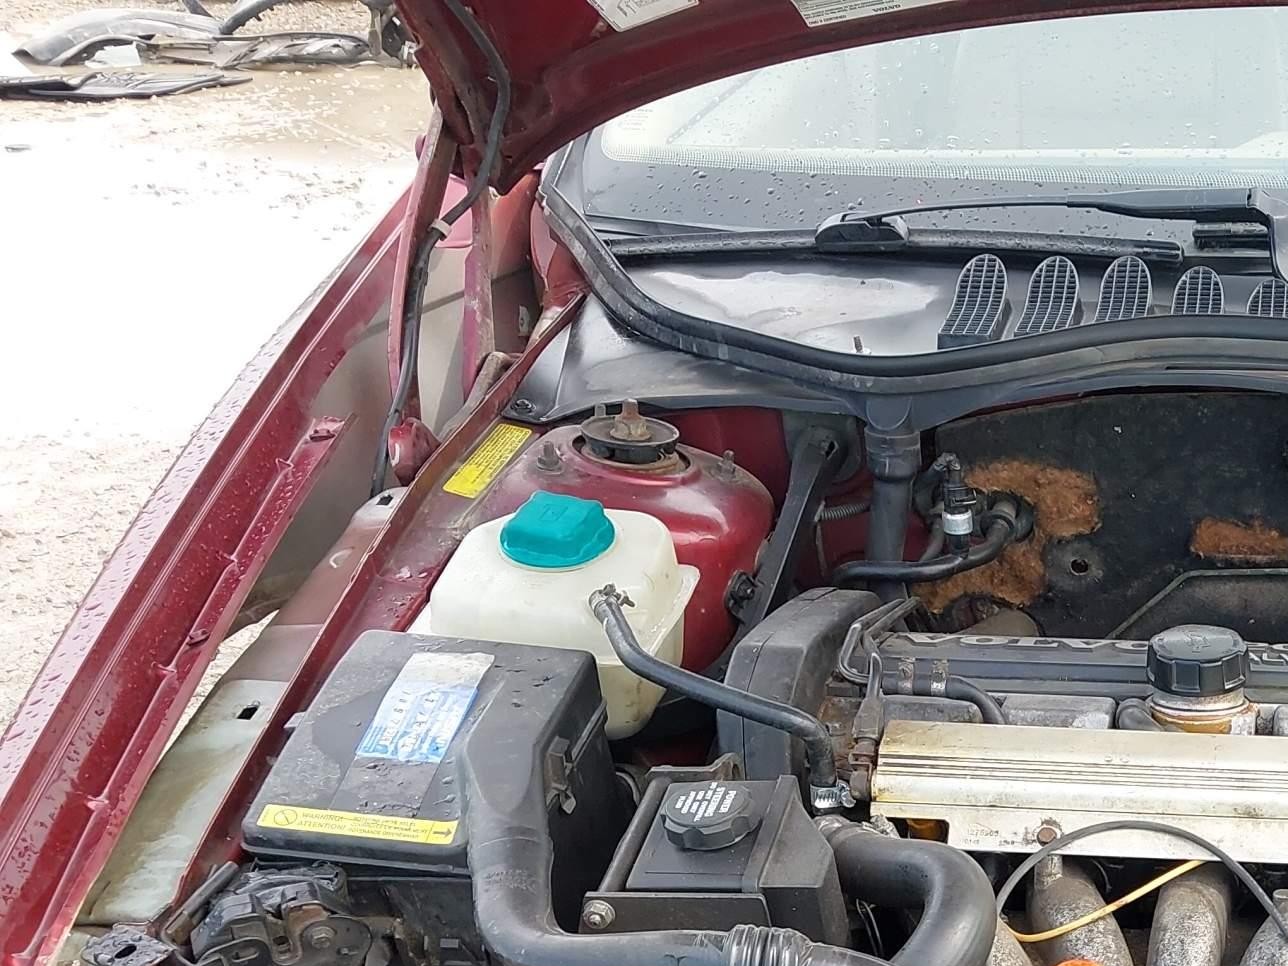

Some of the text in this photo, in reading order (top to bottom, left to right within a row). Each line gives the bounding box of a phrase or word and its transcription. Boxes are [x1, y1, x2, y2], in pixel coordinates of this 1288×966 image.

[904, 632, 1148, 651] VOLVO
[704, 786, 726, 817] STEERING
[719, 790, 737, 813] POWER
[296, 820, 347, 831] ATTENTION!
